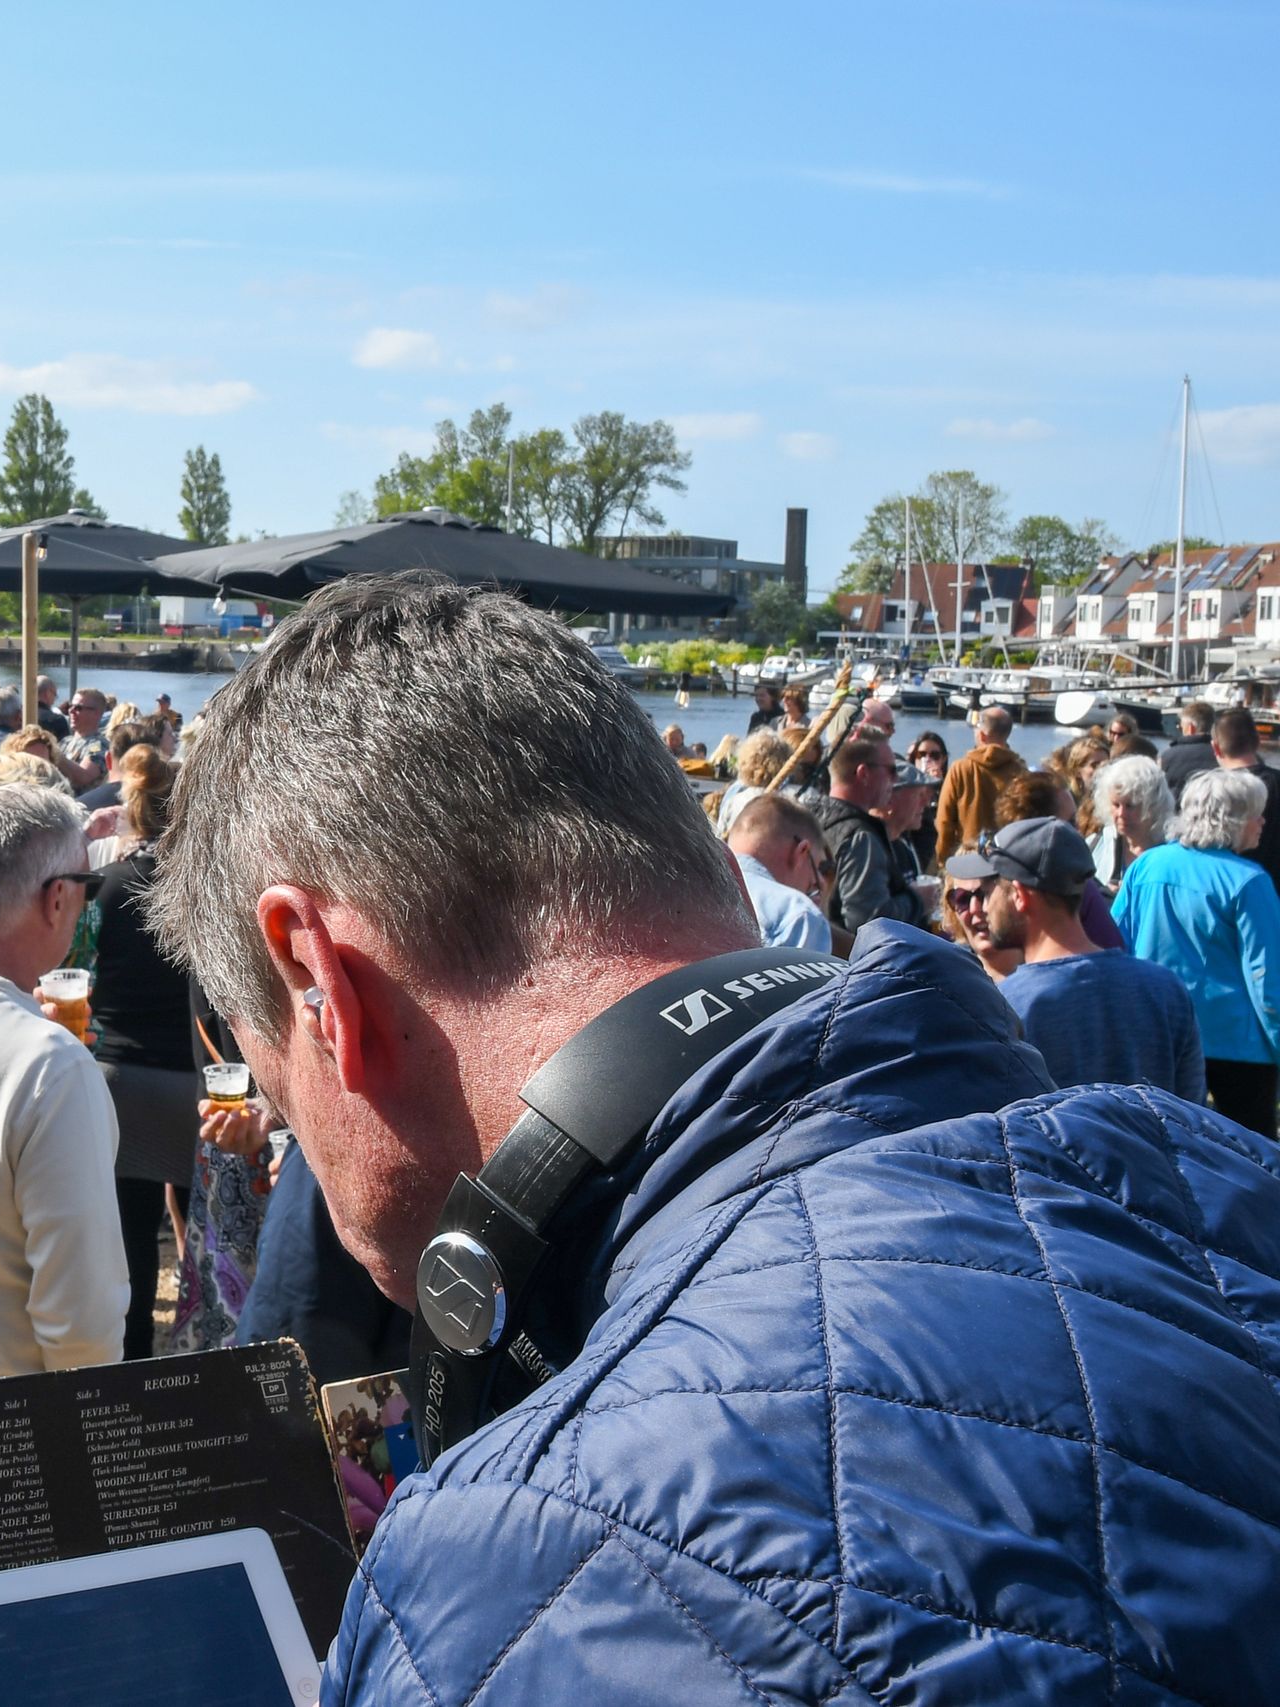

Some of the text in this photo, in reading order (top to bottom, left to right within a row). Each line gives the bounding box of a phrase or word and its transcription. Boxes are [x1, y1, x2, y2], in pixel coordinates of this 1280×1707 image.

[144, 1375, 191, 1391] RECORD
[269, 1385, 279, 1393] DP
[76, 1390, 93, 1400] Side
[425, 1366, 445, 1437] HD 205
[4, 1400, 21, 1410] Side
[80, 1406, 111, 1419] FEVER
[106, 1428, 128, 1439] NOW
[130, 1426, 143, 1435] OR
[145, 1421, 176, 1433] NEVER
[90, 1454, 110, 1465] ARE
[111, 1451, 131, 1462] YOU
[133, 1443, 183, 1459] LONESOME
[95, 1474, 136, 1489] WOODEN
[138, 1468, 170, 1482] HEART
[4, 1491, 25, 1503] DOG
[103, 1504, 160, 1522] SURRENDER
[108, 1534, 134, 1546] WILD
[135, 1531, 146, 1541] IN
[147, 1528, 168, 1539] THE
[170, 1520, 214, 1536] COUNTRY
